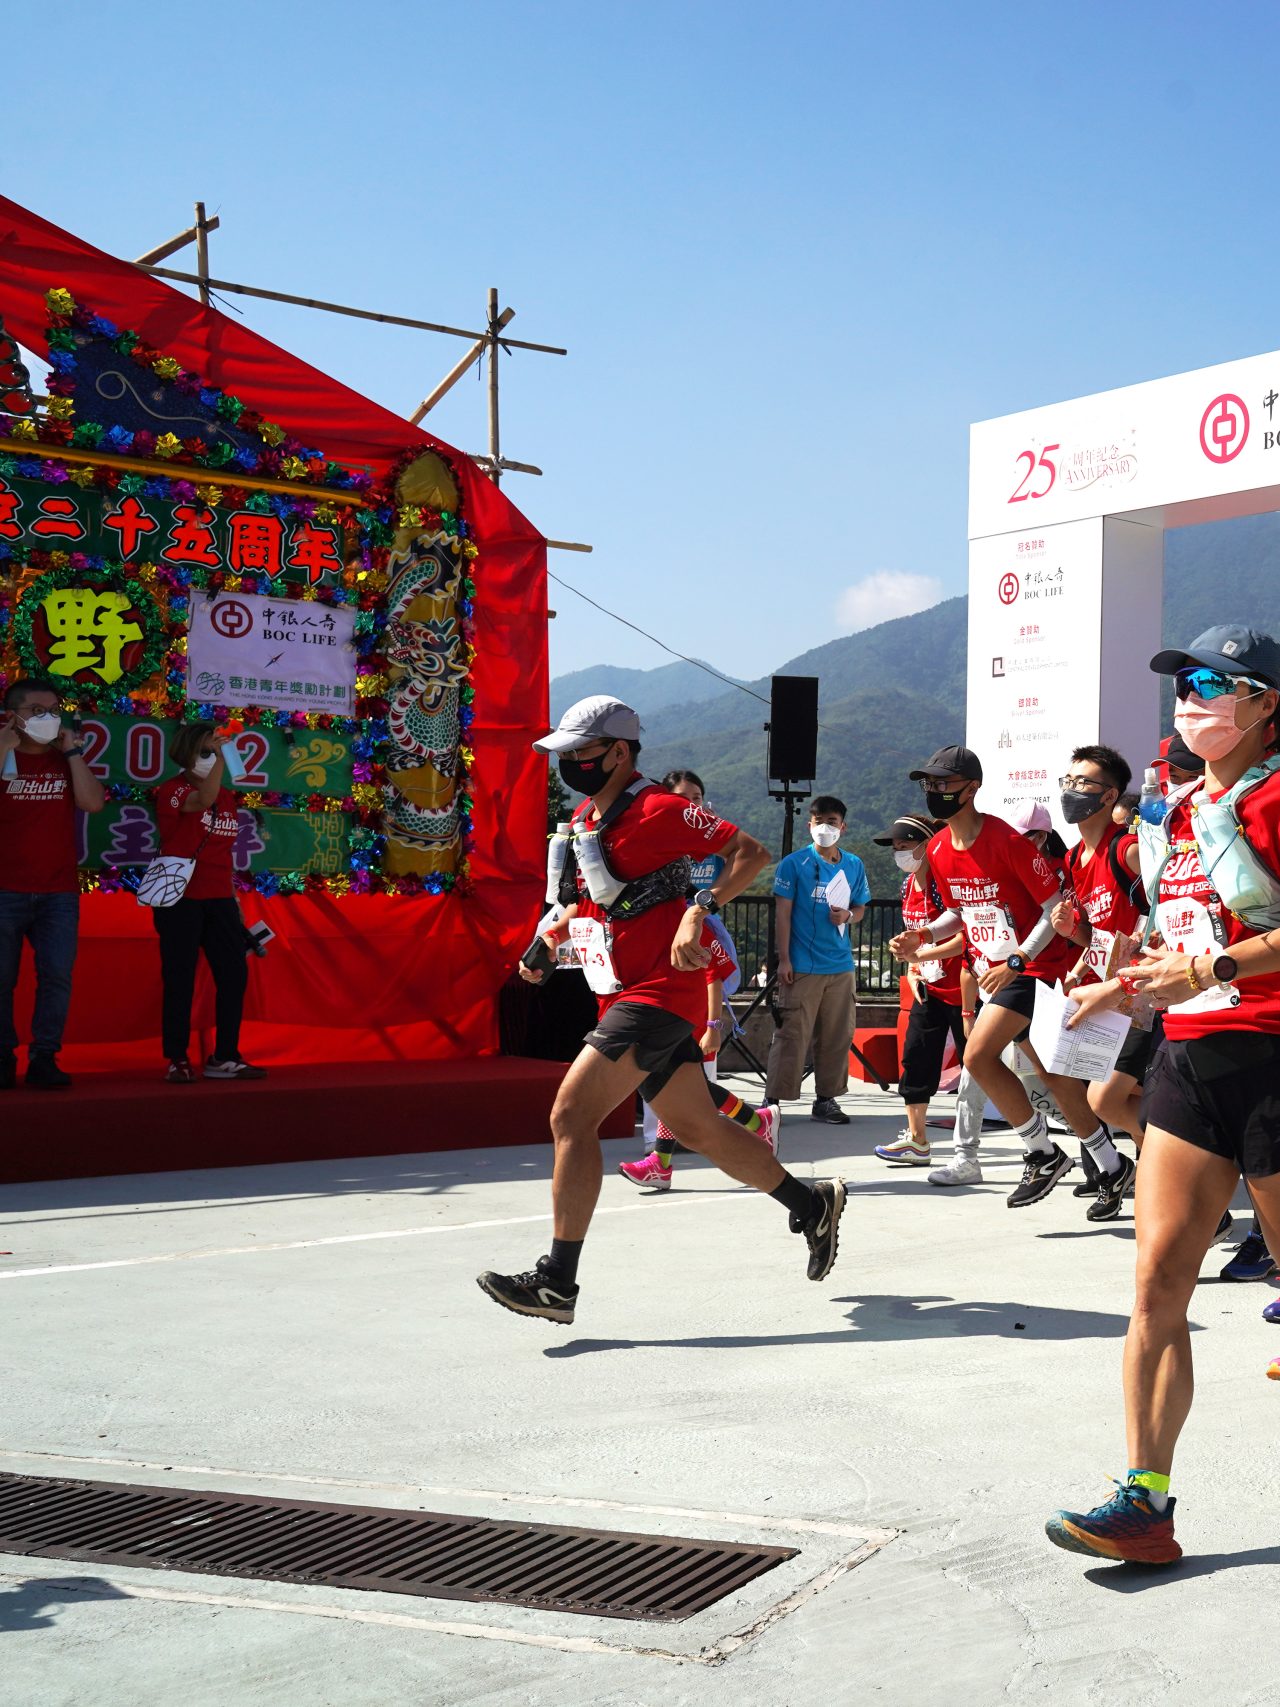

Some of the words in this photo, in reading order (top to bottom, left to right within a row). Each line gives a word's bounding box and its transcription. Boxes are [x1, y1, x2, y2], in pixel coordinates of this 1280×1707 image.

[1007, 443, 1060, 503] 25
[1024, 589, 1041, 600] BOC
[1045, 586, 1064, 597] LIFE
[40, 588, 144, 684] 野
[263, 629, 296, 642] BOC
[303, 633, 337, 646] LIFE
[229, 676, 346, 699] 香港青年獎勵計劃
[79, 720, 269, 787] 202
[950, 883, 1000, 901] 圖出山野
[971, 926, 1010, 943] 807-3
